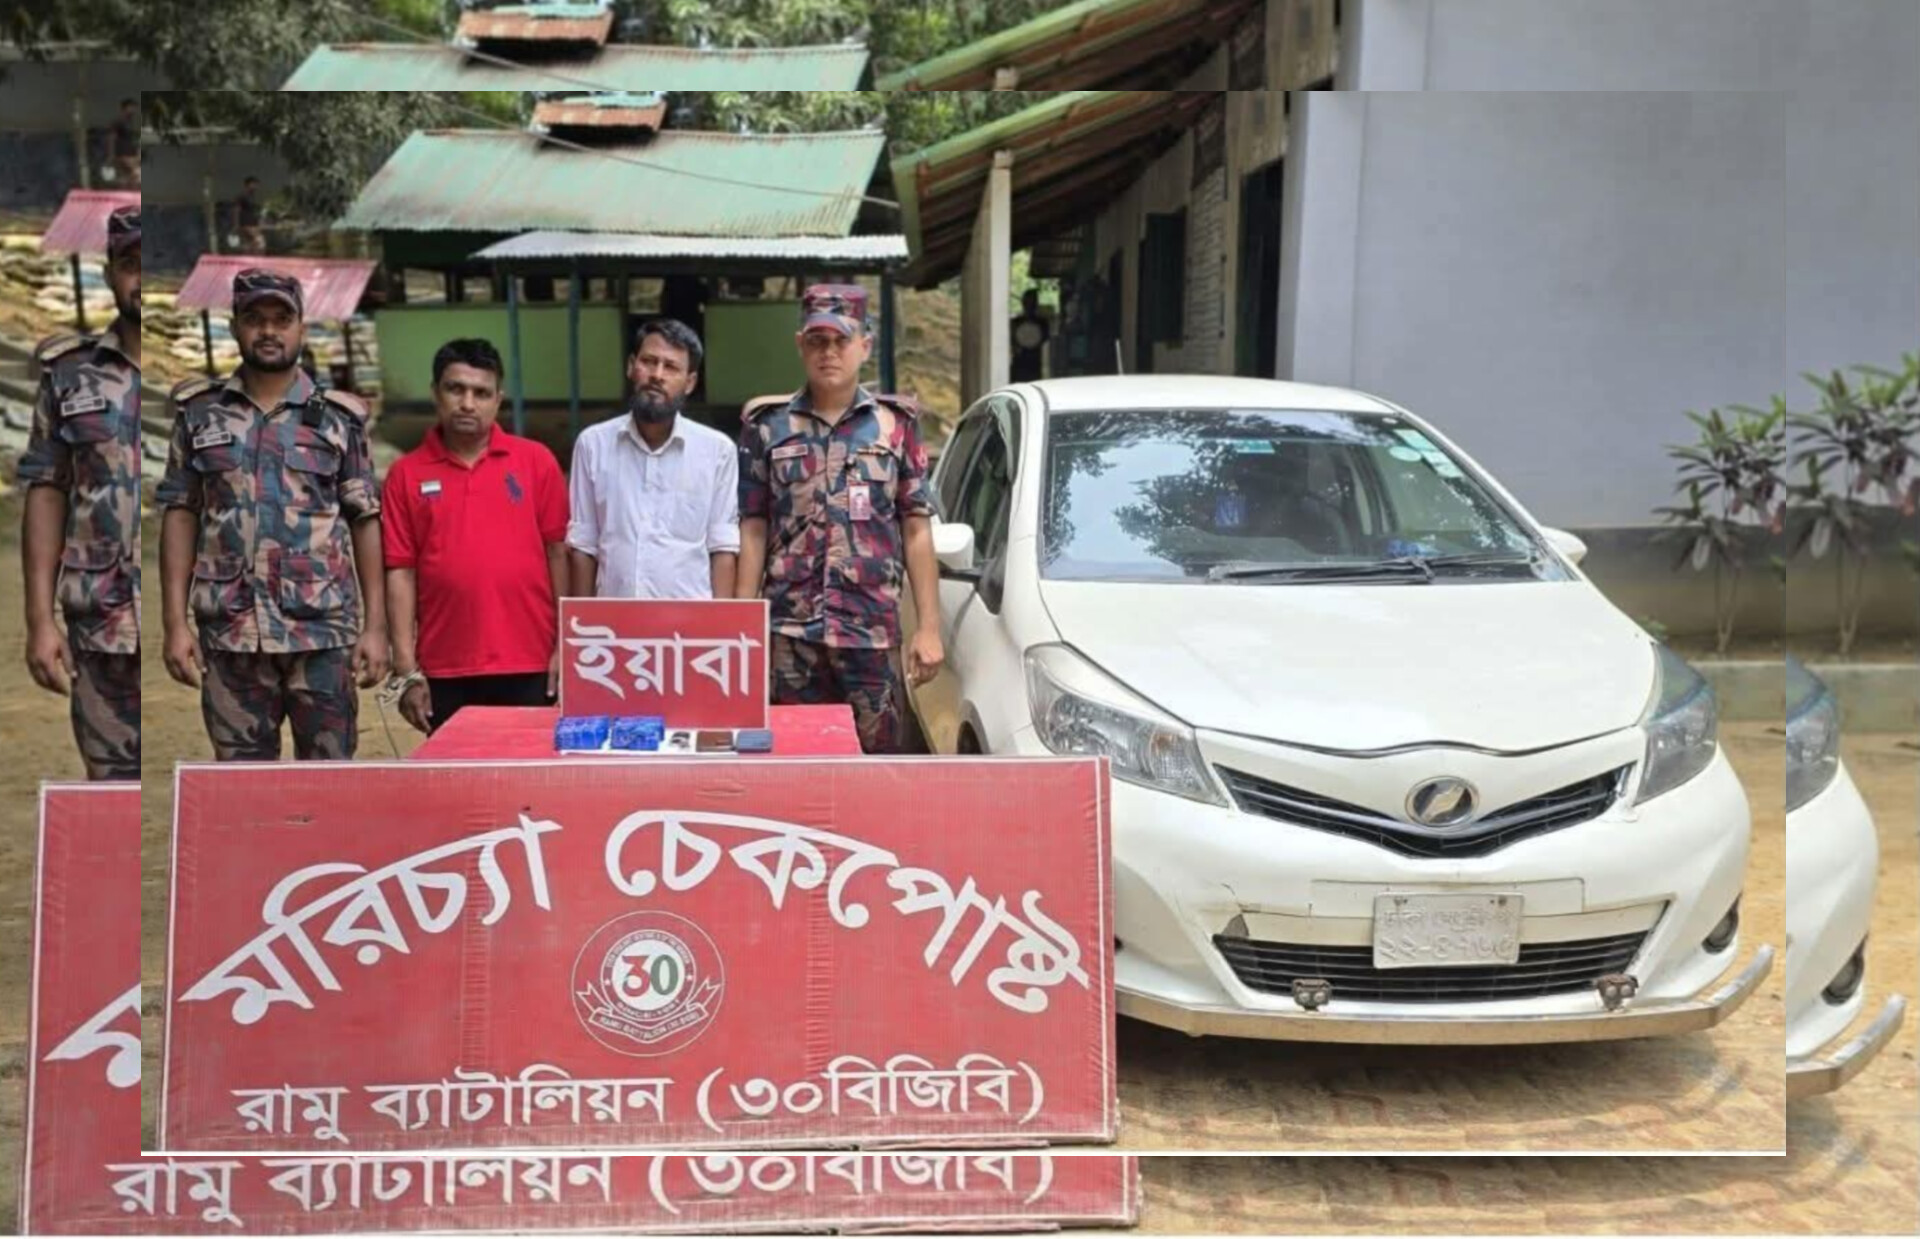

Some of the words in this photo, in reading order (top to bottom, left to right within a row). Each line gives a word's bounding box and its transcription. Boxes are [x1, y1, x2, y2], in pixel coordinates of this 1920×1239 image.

[565, 616, 762, 699] ইয়াবা
[179, 814, 562, 1025] মরিচ্যা
[622, 954, 679, 997] 30
[231, 1082, 349, 1144] রামু
[364, 1063, 674, 1131] ব্যাটালিয়ন
[105, 1157, 243, 1227] রামু
